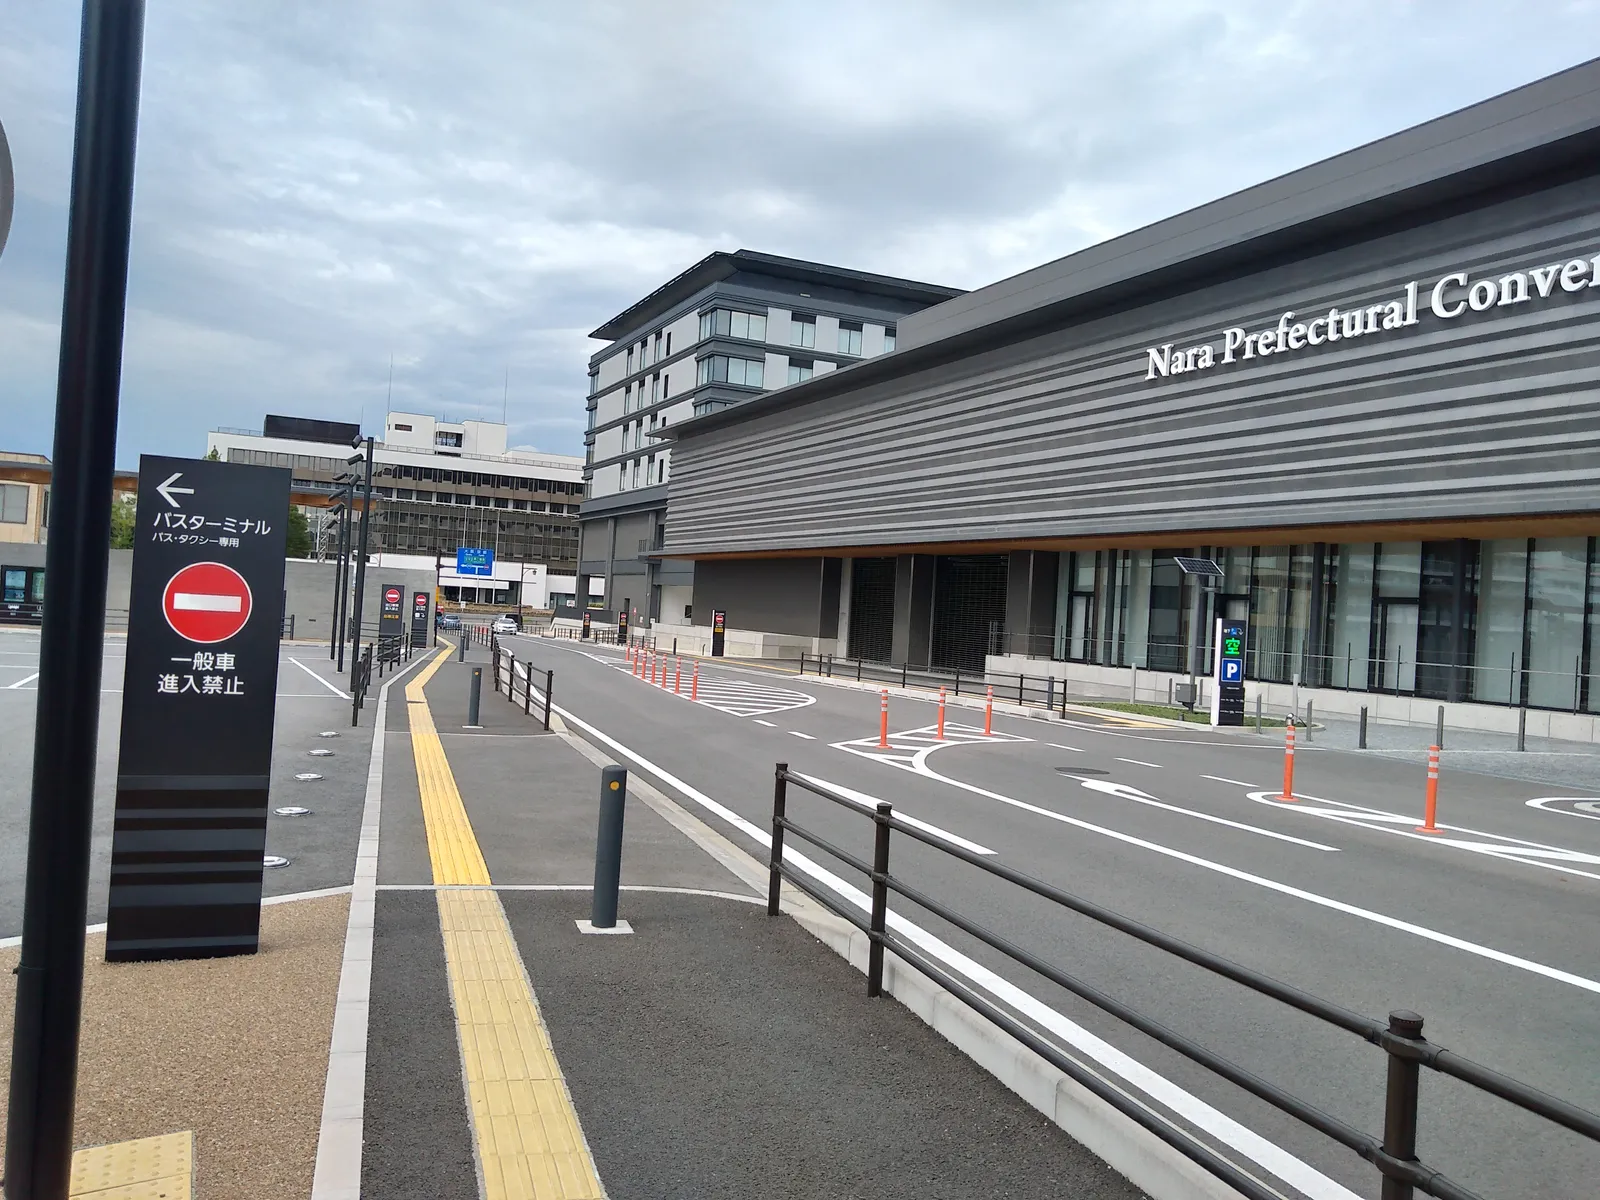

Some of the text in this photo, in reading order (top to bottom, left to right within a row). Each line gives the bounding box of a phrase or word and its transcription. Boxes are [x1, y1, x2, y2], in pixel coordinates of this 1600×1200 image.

[1144, 344, 1215, 380] Nara
[1220, 280, 1420, 365] Prefectural
[153, 512, 271, 536] バスターミナル
[152, 531, 240, 548] バス・タクシー専用
[1224, 637, 1241, 655] 空
[170, 651, 236, 672] 一般車
[1226, 662, 1238, 679] P
[157, 673, 245, 696] 進入禁止
